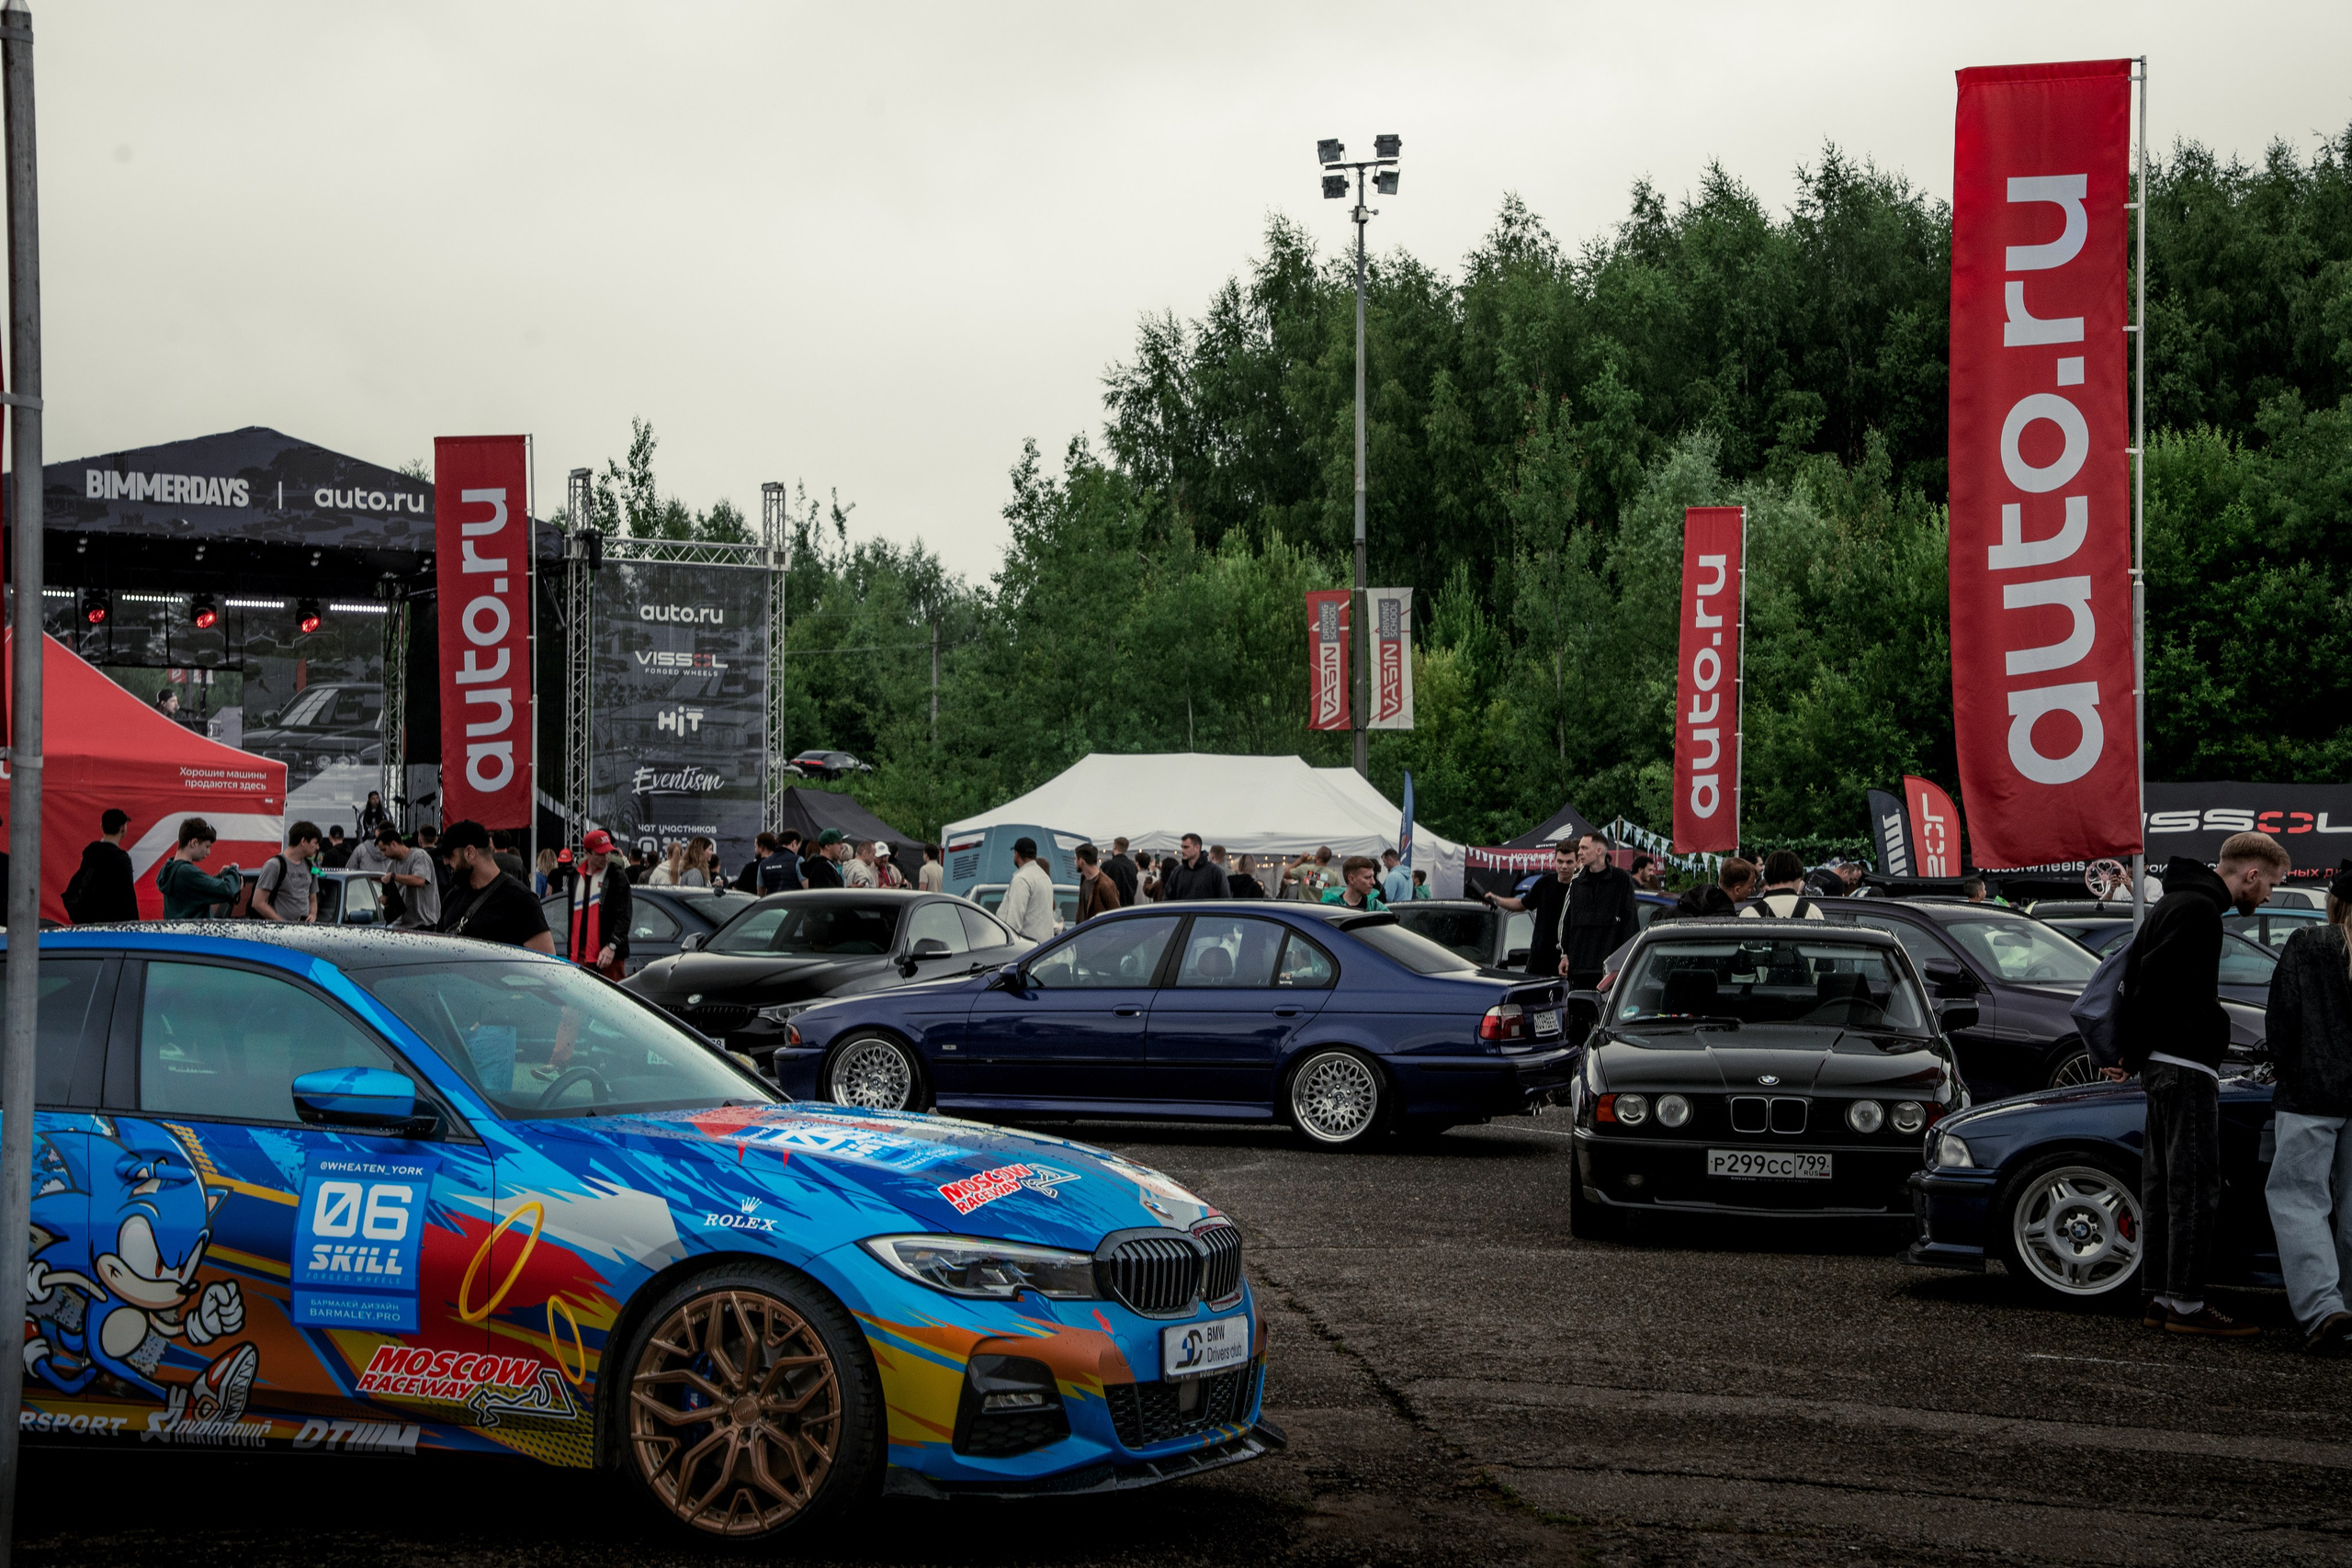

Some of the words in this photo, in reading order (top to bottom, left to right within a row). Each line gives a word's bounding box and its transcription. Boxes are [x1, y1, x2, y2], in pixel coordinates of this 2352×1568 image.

[85, 469, 249, 507] BIMMERDAYS
[1987, 174, 2105, 784] auto.ru
[314, 487, 424, 513] auto.ru
[639, 604, 723, 624] auto.ru
[456, 488, 514, 793] auto.ru
[635, 650, 729, 669] VISSOL
[1688, 554, 1726, 818] auto.ru
[180, 766, 225, 778] Хорошие
[226, 770, 266, 780] машины
[631, 765, 725, 795] Eventism
[185, 779, 238, 789] продаются
[240, 782, 266, 791] здесь
[320, 1161, 424, 1176] @WHEATEN_YORK
[1796, 1155, 1826, 1170] 799
[937, 1163, 1035, 1206] MOSCOW
[956, 1179, 1021, 1215] RACEWAY
[312, 1180, 413, 1241] 06
[703, 1213, 778, 1232] ROLEX
[306, 1273, 350, 1282] FORGED
[356, 1275, 401, 1284] WHEELS
[310, 1308, 401, 1322] BARMALEY.PRO
[311, 1298, 358, 1309] БАРМАЛЕЙ
[360, 1300, 399, 1311] ДИЗАЙН
[1207, 1325, 1225, 1341] BMW
[1207, 1347, 1229, 1362] Drivers
[1230, 1342, 1242, 1358] club
[368, 1345, 540, 1388] MOSCOW
[356, 1372, 478, 1401] RACEWAY
[19, 1411, 127, 1436] RSPORT
